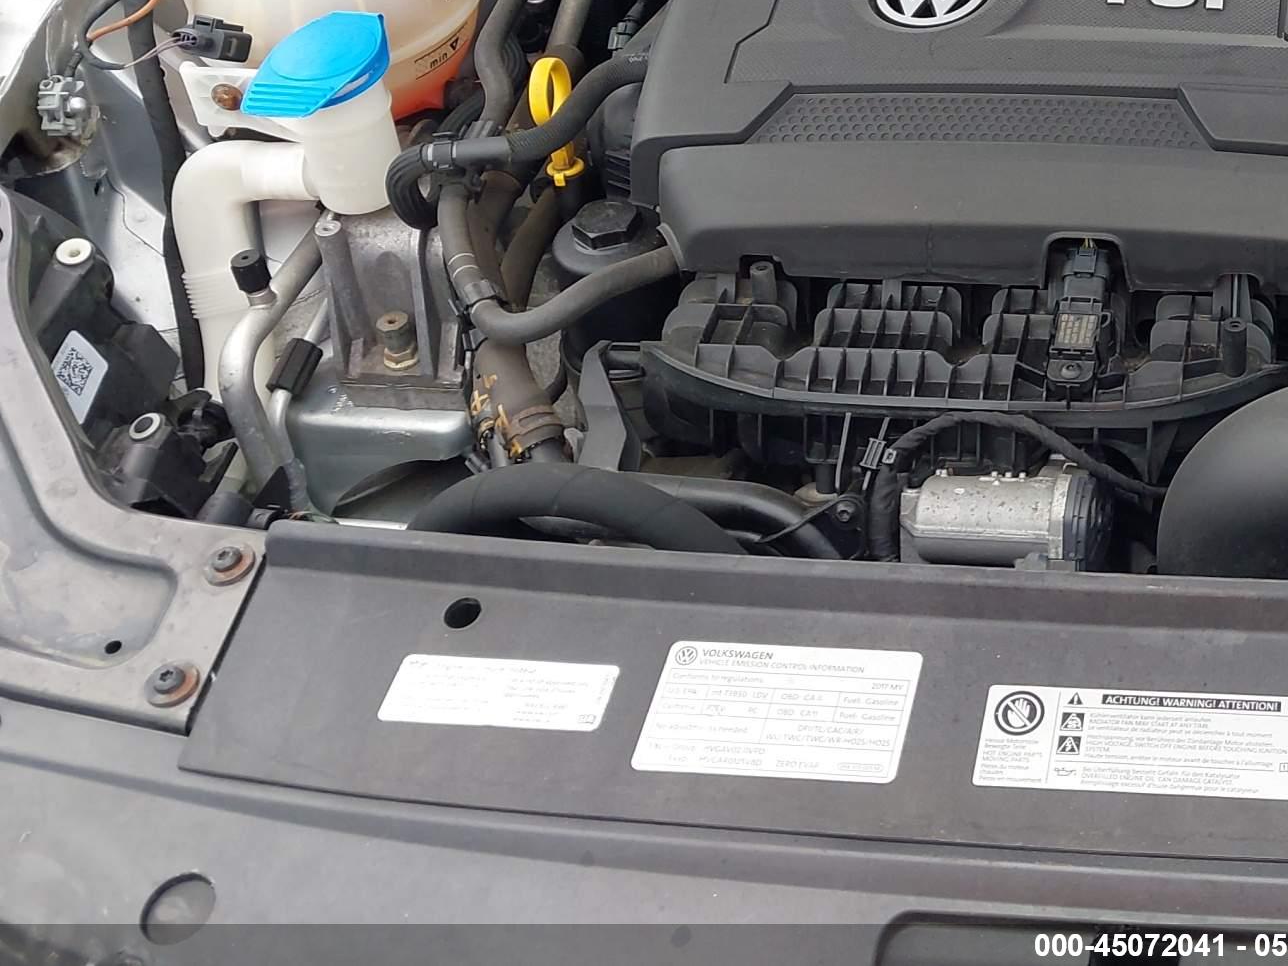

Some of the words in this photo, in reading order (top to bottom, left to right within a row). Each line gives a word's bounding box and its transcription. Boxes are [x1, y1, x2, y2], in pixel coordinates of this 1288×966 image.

[430, 53, 447, 68] min
[702, 649, 773, 660] VOLKSWAGEN
[731, 660, 768, 668] EMISSION
[771, 662, 808, 670] CONTROL
[809, 664, 864, 673] INFORMATION
[872, 682, 888, 690] 2017
[865, 698, 898, 706] Gasoline
[1106, 695, 1160, 706] ACHTUNG!
[1163, 698, 1216, 708] WARNING!
[1218, 700, 1278, 711] ATTENTION!
